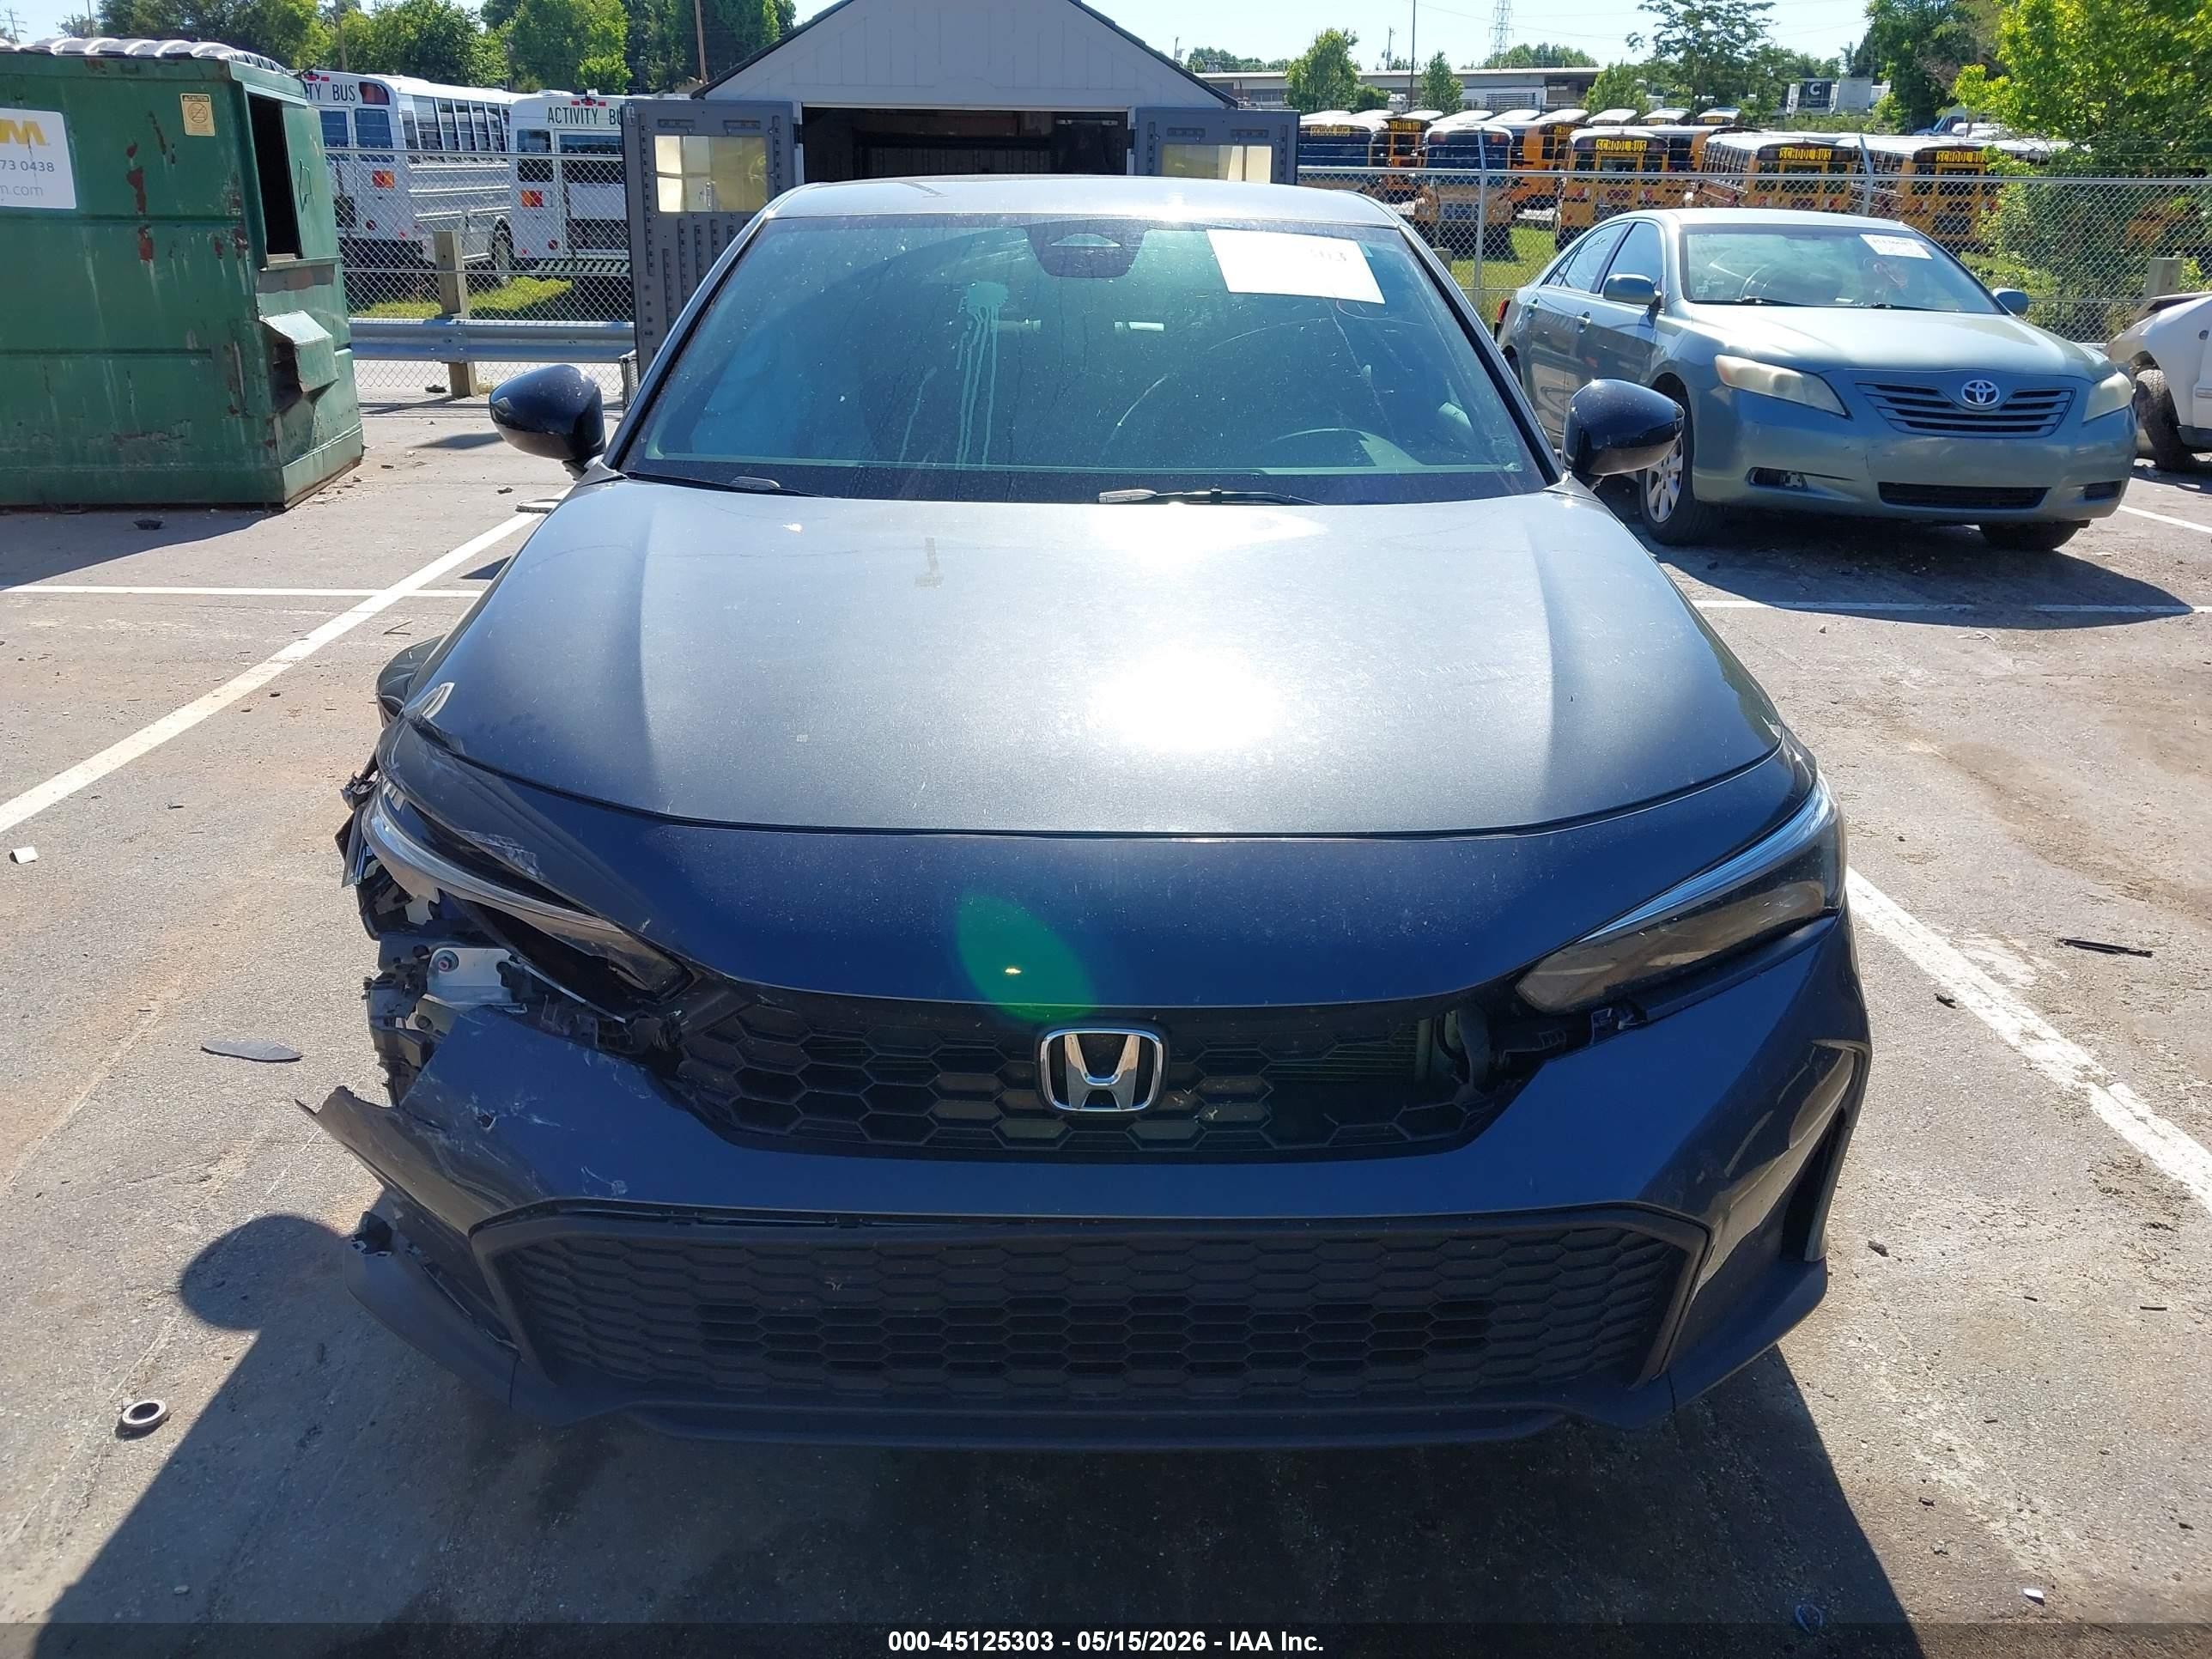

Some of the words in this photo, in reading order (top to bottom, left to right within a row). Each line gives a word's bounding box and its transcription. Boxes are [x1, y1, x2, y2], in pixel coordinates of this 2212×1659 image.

[332, 84, 356, 101] BUS
[547, 106, 599, 125] ACTIVITY
[1597, 140, 1626, 150] SCHOOL
[1631, 141, 1645, 151] BUS
[1780, 149, 1810, 160] SCHOOL
[1814, 150, 1830, 161] BUS
[1937, 151, 1968, 161] SCHOOL
[21, 161, 54, 172] 0438
